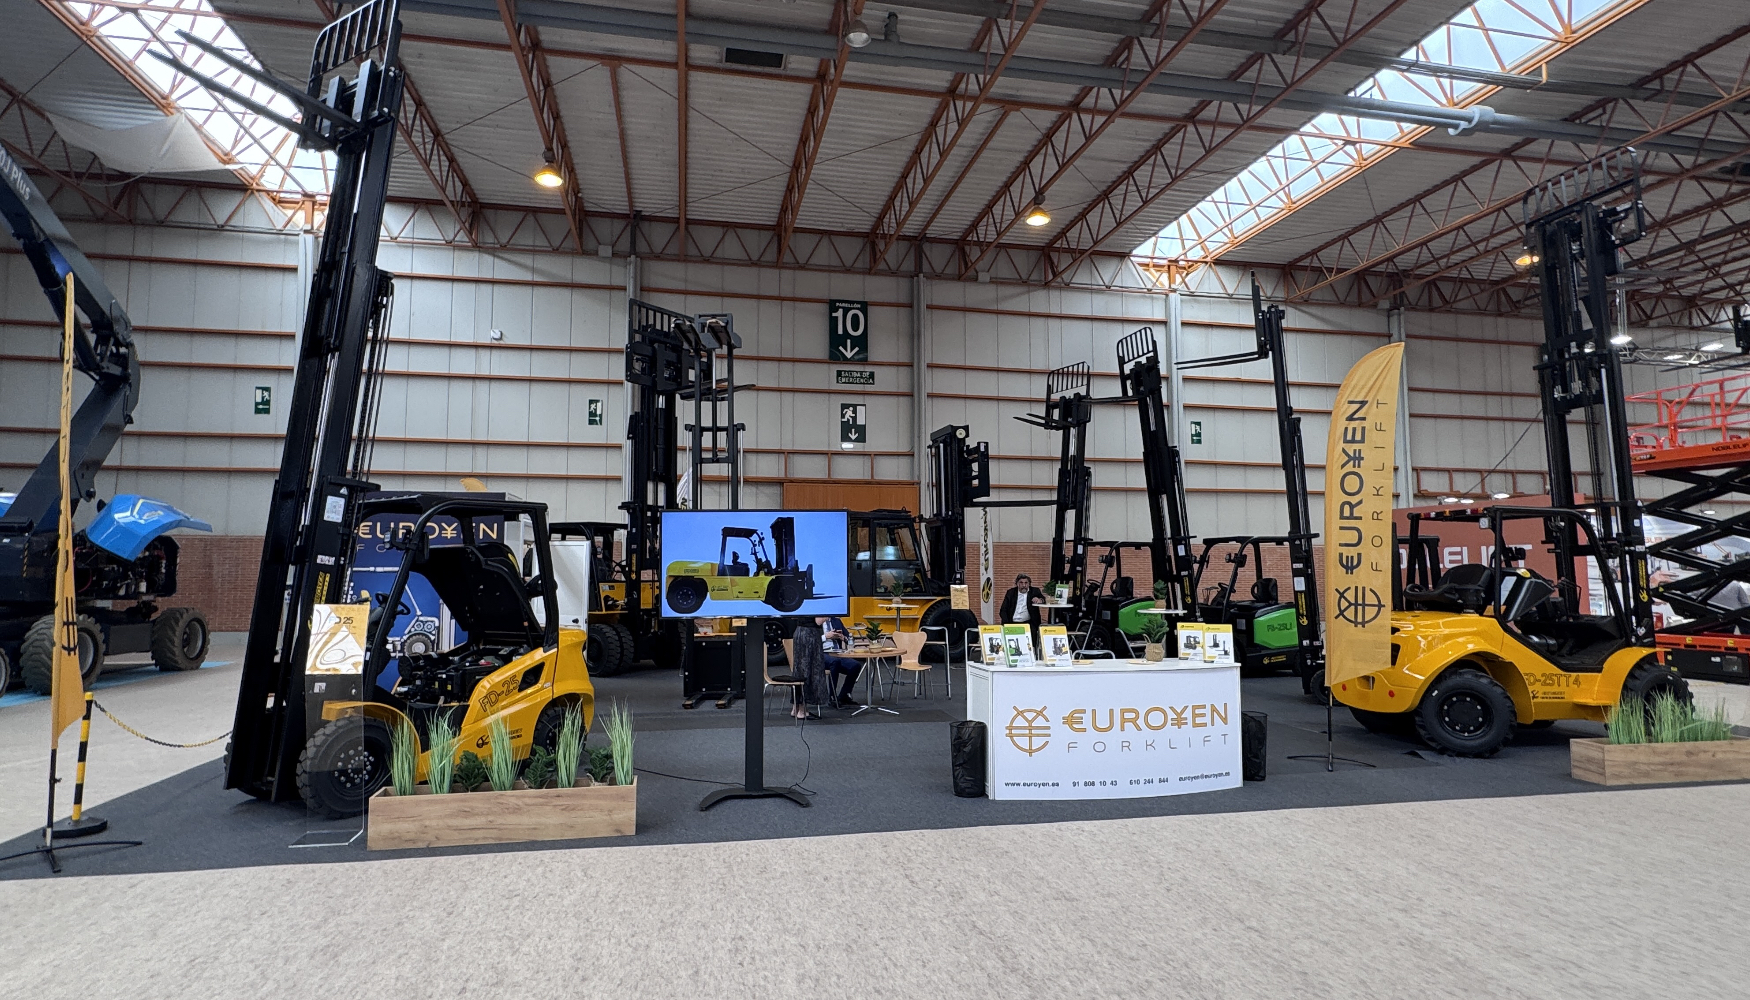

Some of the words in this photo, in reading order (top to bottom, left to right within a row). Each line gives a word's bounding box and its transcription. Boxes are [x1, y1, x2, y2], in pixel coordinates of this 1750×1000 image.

[10, 163, 30, 200] Plus
[832, 308, 865, 336] 10
[1371, 398, 1388, 572] FORKLIFT
[342, 616, 354, 625] 25
[478, 674, 520, 713] FD-25
[1067, 733, 1229, 753] FORKLIFT
[1004, 781, 1060, 789] www.euroyen.es
[1072, 780, 1080, 788] 91
[1099, 779, 1107, 787] 10
[1109, 779, 1118, 787] 43
